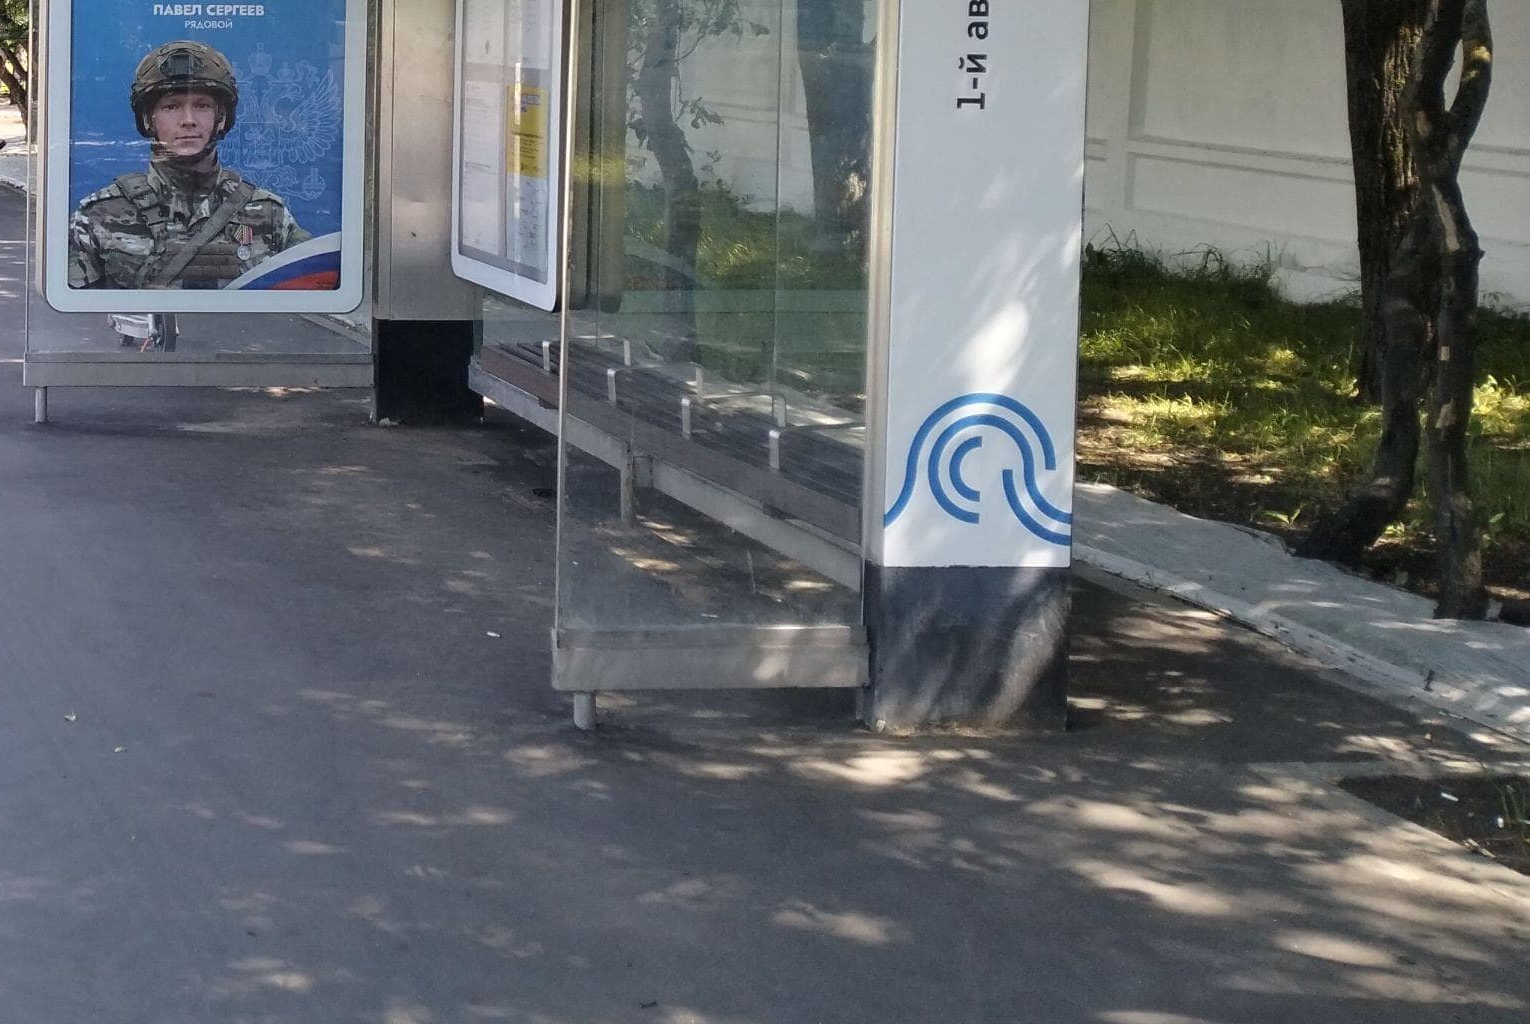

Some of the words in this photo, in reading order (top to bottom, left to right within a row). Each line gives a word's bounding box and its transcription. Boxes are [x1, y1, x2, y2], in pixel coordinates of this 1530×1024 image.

[153, 3, 202, 17] ПАВЕЛ
[206, 3, 265, 17] СЕРГЕЕВ
[184, 19, 234, 30] РЯДОВОЙ
[956, 53, 988, 110] 1-й
